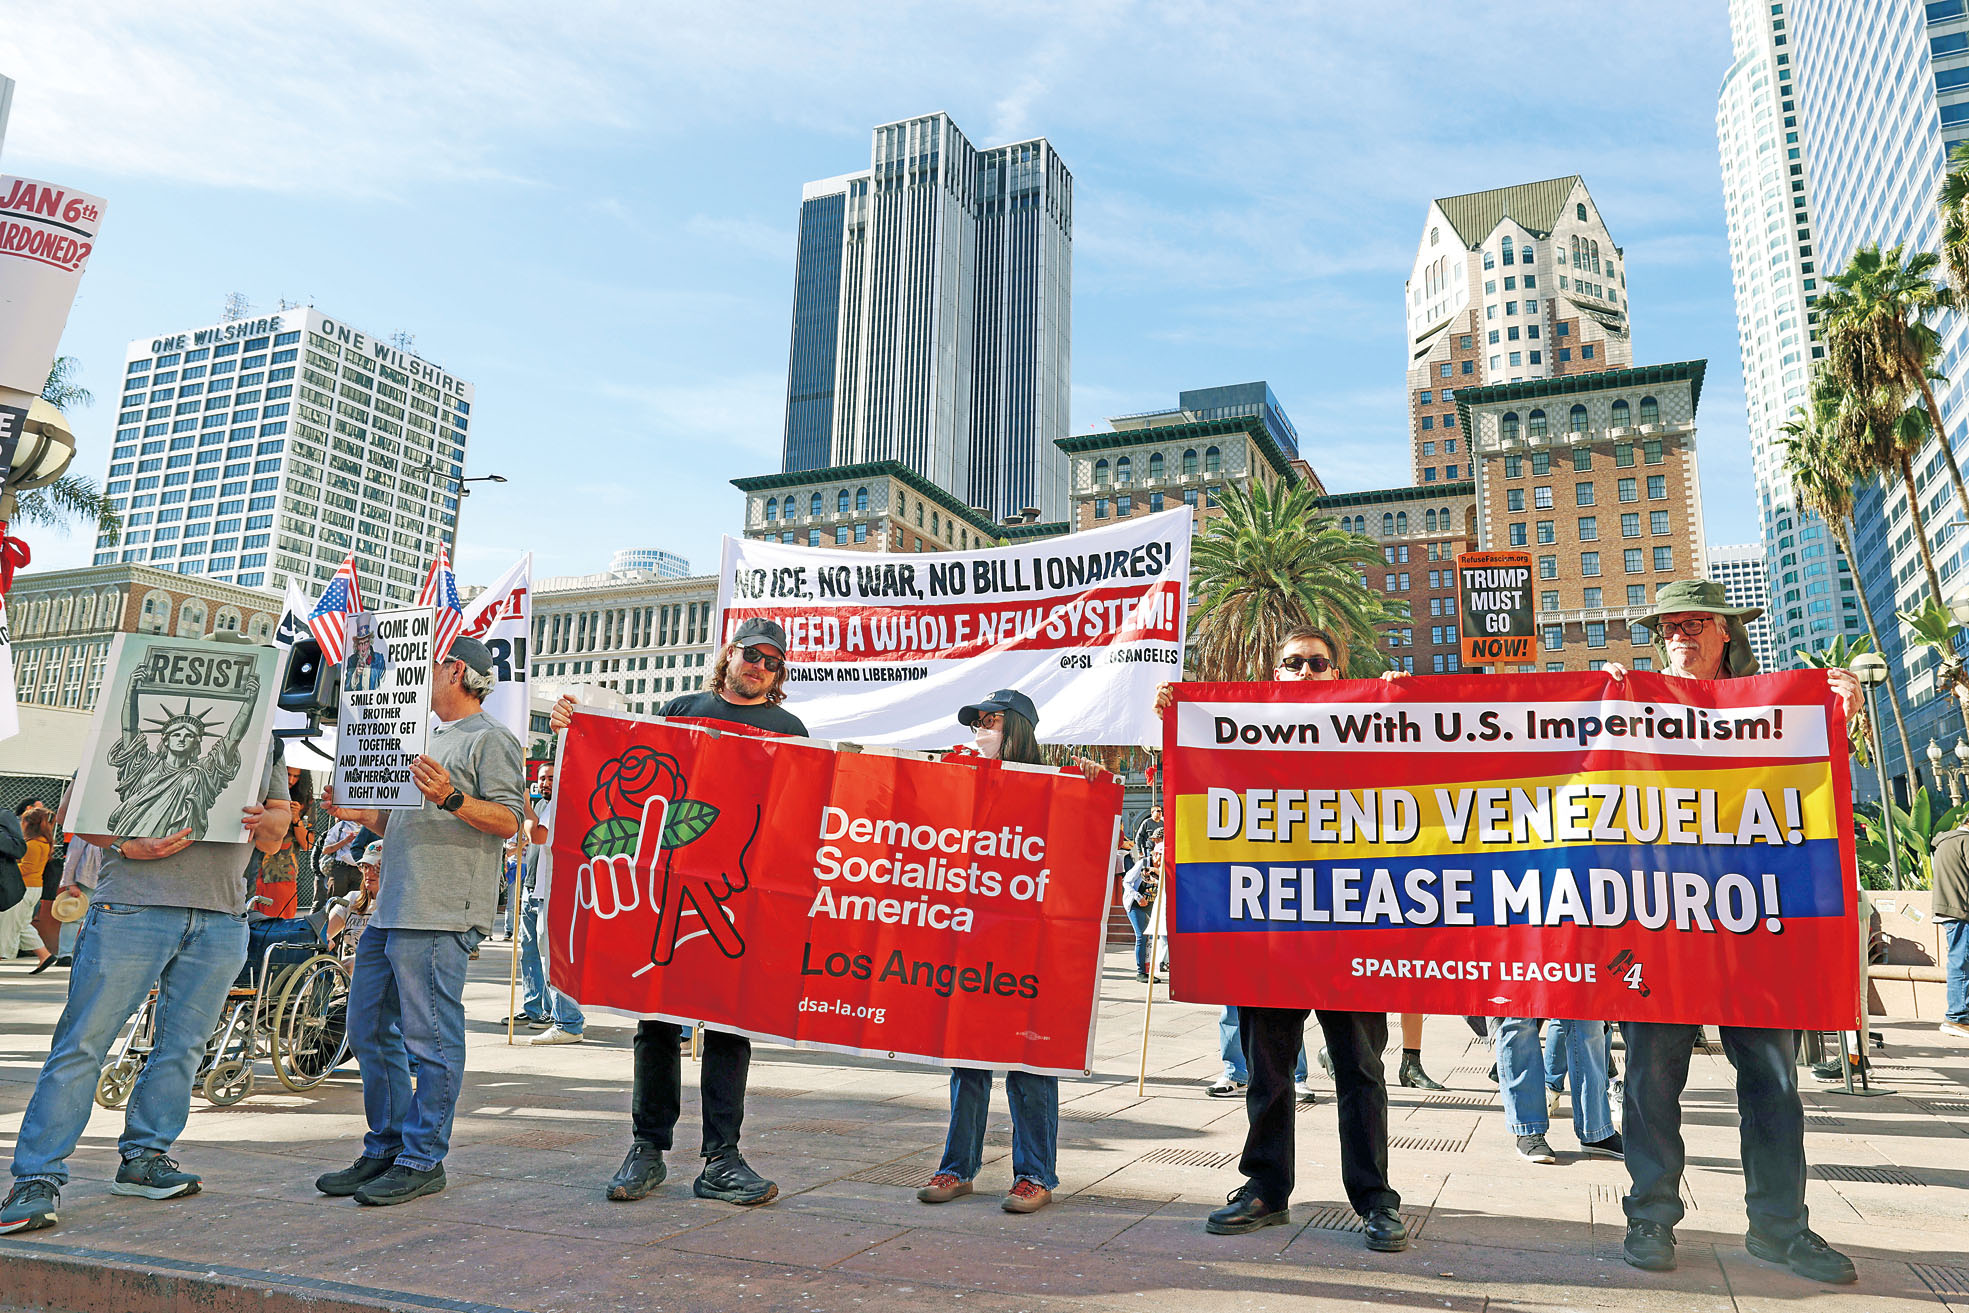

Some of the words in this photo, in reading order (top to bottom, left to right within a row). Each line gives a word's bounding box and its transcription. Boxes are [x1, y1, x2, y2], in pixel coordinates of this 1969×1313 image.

[0, 180, 64, 217] JAN
[62, 198, 98, 223] 6th
[151, 334, 185, 354] ONE
[194, 316, 280, 346] WILSHIRE
[321, 319, 364, 351] ONE
[374, 342, 466, 397] WILSHIRE
[1461, 555, 1528, 563] RefuseFascism.org
[734, 568, 767, 600] NO
[770, 566, 814, 601] ICE,
[818, 565, 851, 597] NO
[856, 563, 924, 600] WAR,
[929, 562, 966, 597] NO
[972, 541, 1173, 594] BILLIONAIRES!
[1462, 568, 1529, 589] TRUMP
[1471, 590, 1523, 611] MUST
[377, 619, 408, 640] COME
[412, 617, 429, 637] ON
[846, 615, 865, 652] A
[870, 613, 971, 652] WHOLE
[977, 607, 1043, 646] NEW
[1046, 592, 1175, 639] SYSTEM!
[1485, 613, 1511, 633] GO
[388, 641, 428, 663] PEOPLE
[1471, 638, 1529, 658] NOW!
[150, 654, 251, 690] RESIST
[1060, 655, 1092, 669] @PSL
[396, 666, 426, 687] NOW
[837, 667, 860, 682] AND
[863, 667, 928, 682] LIBERATION
[350, 693, 374, 707] SMILE
[376, 692, 389, 706] ON
[392, 691, 417, 704] YOUR
[363, 707, 401, 720] BROTHER
[347, 722, 397, 736] EVERYBODY
[400, 721, 416, 735] GET
[1215, 716, 1319, 744] Down
[1330, 711, 1422, 743] With
[1434, 711, 1514, 743] U.S.
[1527, 706, 1784, 747] Imperialism!
[358, 738, 402, 751] TOGETHER
[339, 754, 357, 767] AND
[359, 754, 397, 767] IMPEACH
[344, 767, 411, 783] MTHERFCKER
[348, 786, 375, 799] RIGHT
[376, 786, 400, 799] NOW
[1207, 787, 1420, 844] DEFEND
[1434, 784, 1806, 846] VENEZUELA!
[819, 805, 1046, 862] Democratic
[813, 845, 1003, 897] Socialists
[1009, 868, 1050, 903] of
[807, 886, 974, 933] America
[1229, 865, 1478, 926] RELEASE
[1491, 867, 1785, 935] MADURO!
[801, 942, 873, 980] Los
[878, 949, 1040, 999] Angeles
[1351, 958, 1492, 981] SPARTACIST
[1500, 961, 1597, 983] LEAGUE
[1623, 962, 1644, 990] 4
[798, 997, 887, 1024] dsa-la.org
